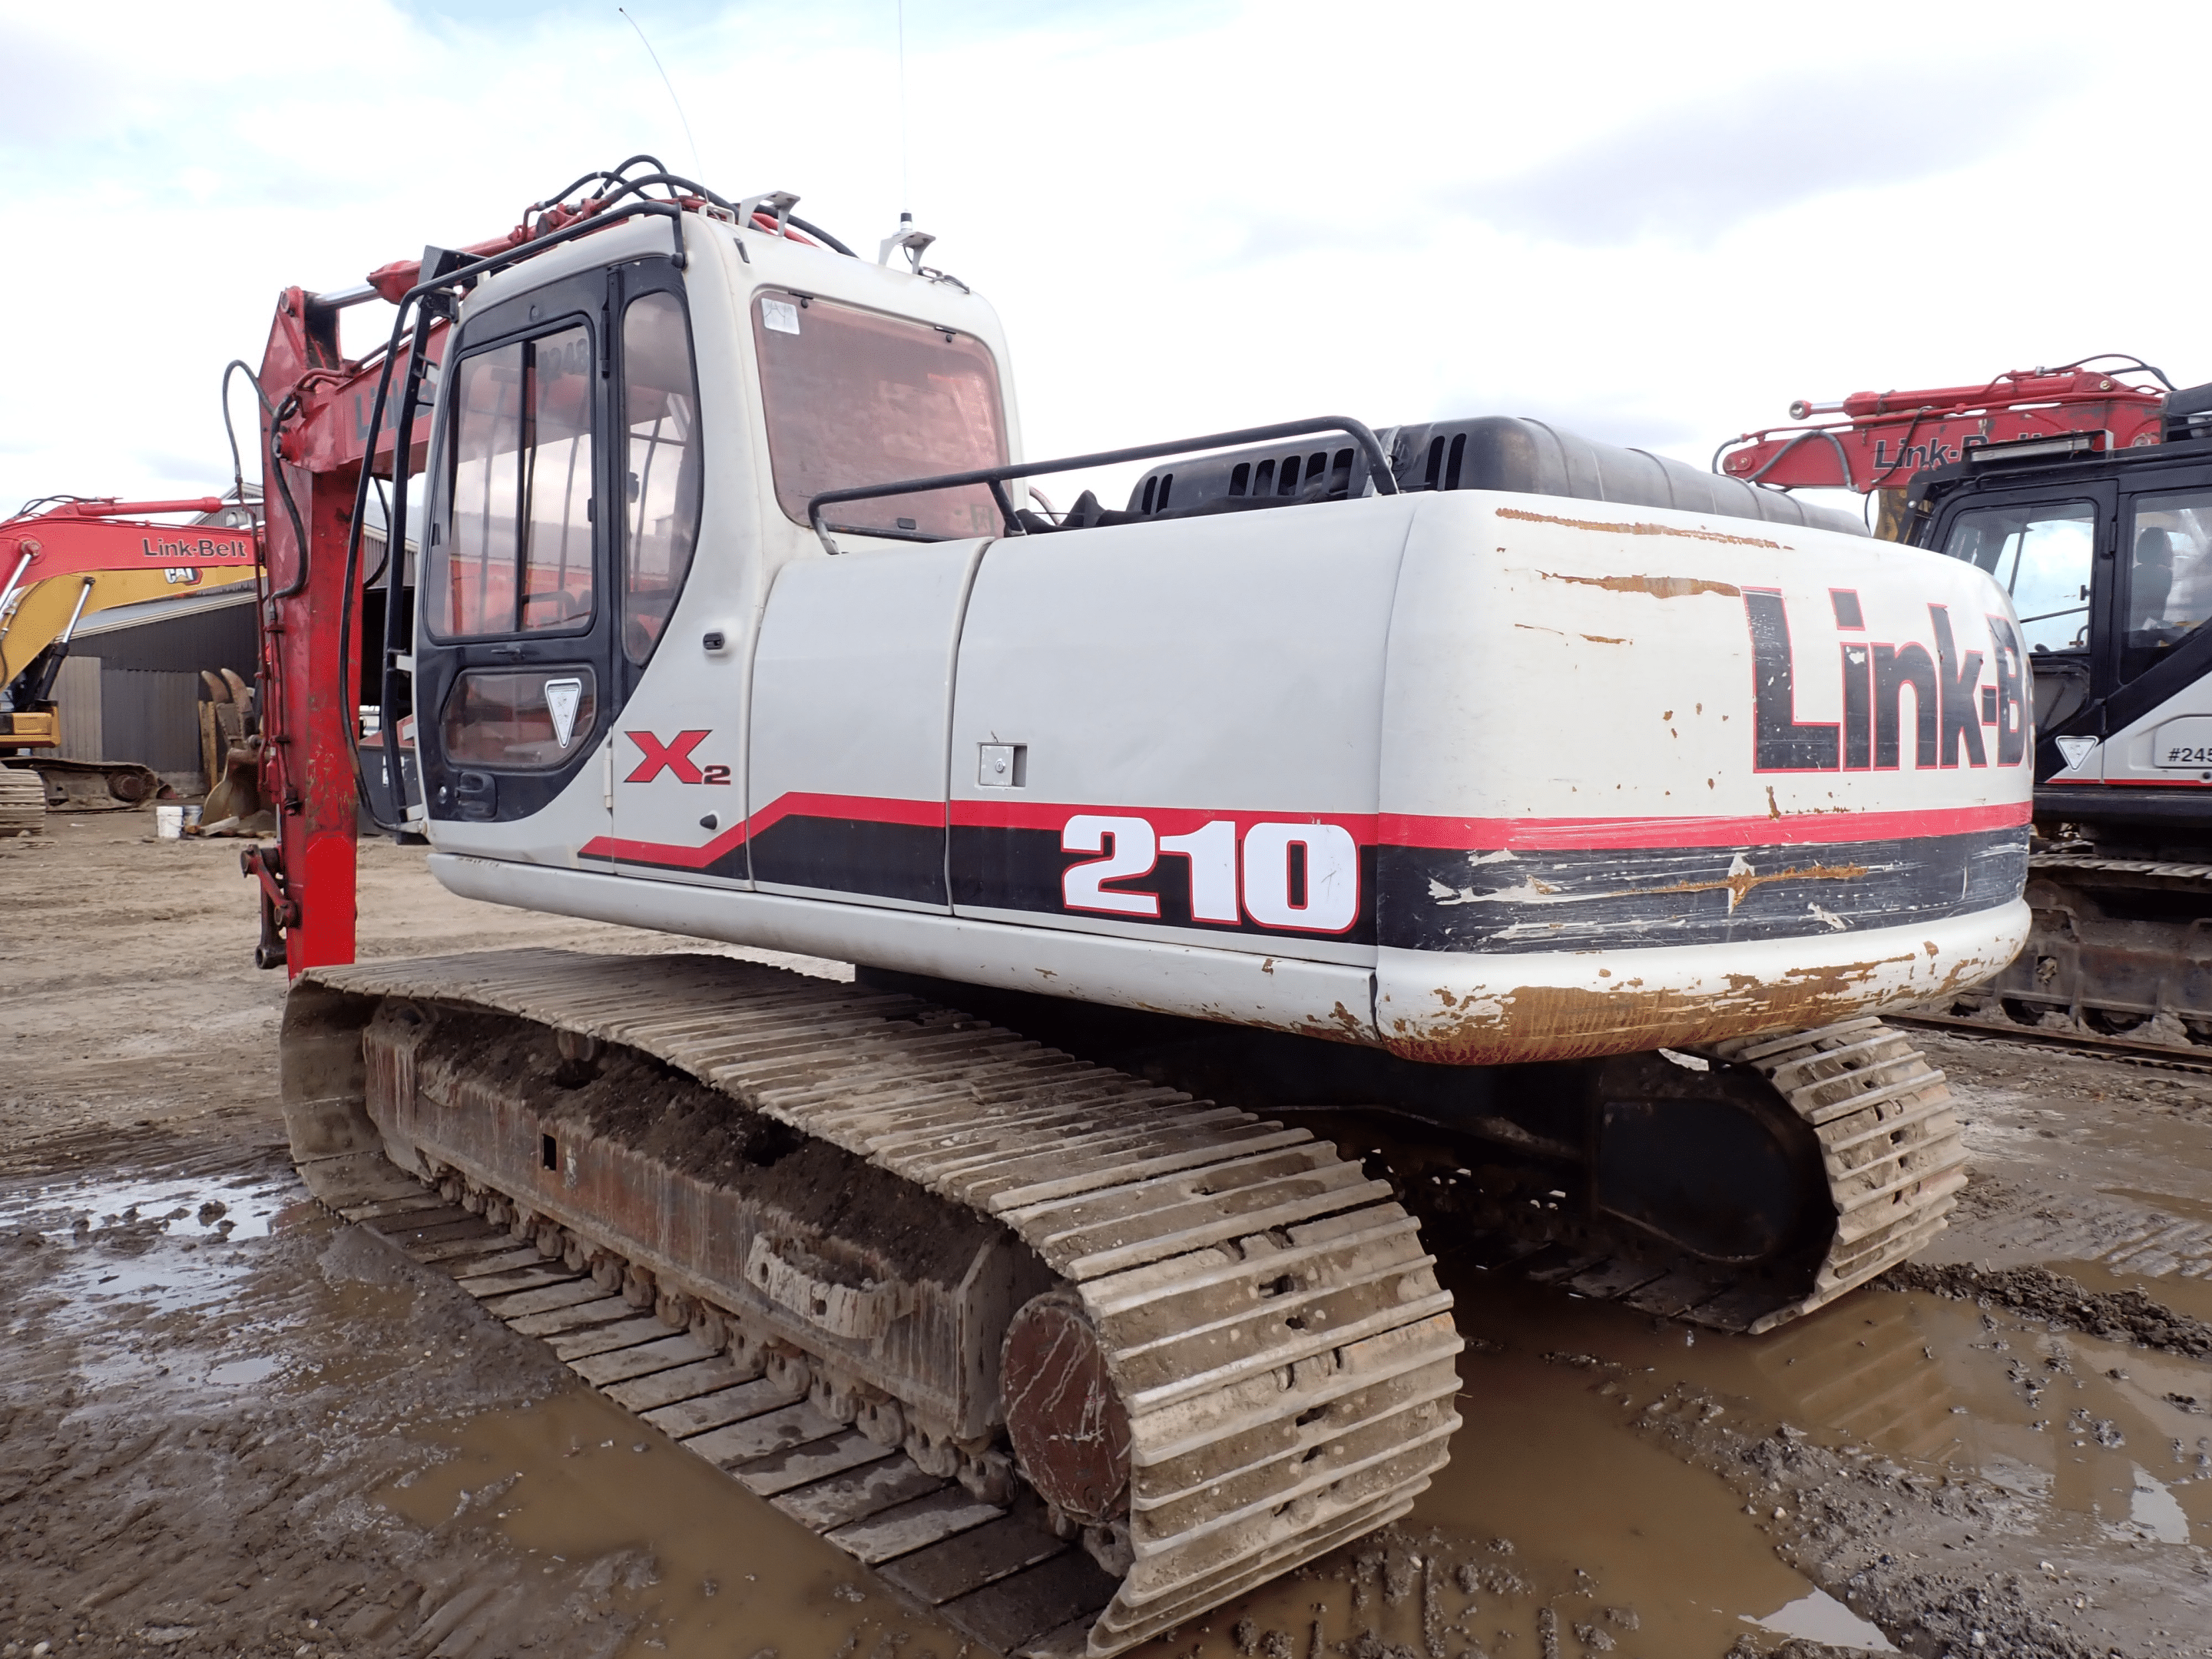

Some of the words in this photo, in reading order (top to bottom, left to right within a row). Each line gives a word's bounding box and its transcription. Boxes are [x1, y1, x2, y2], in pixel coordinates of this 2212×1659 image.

[1873, 432, 2043, 469] Link-
[142, 538, 248, 558] Link-Belt
[1740, 585, 2035, 773] Link-B
[1061, 814, 1360, 934] 210
